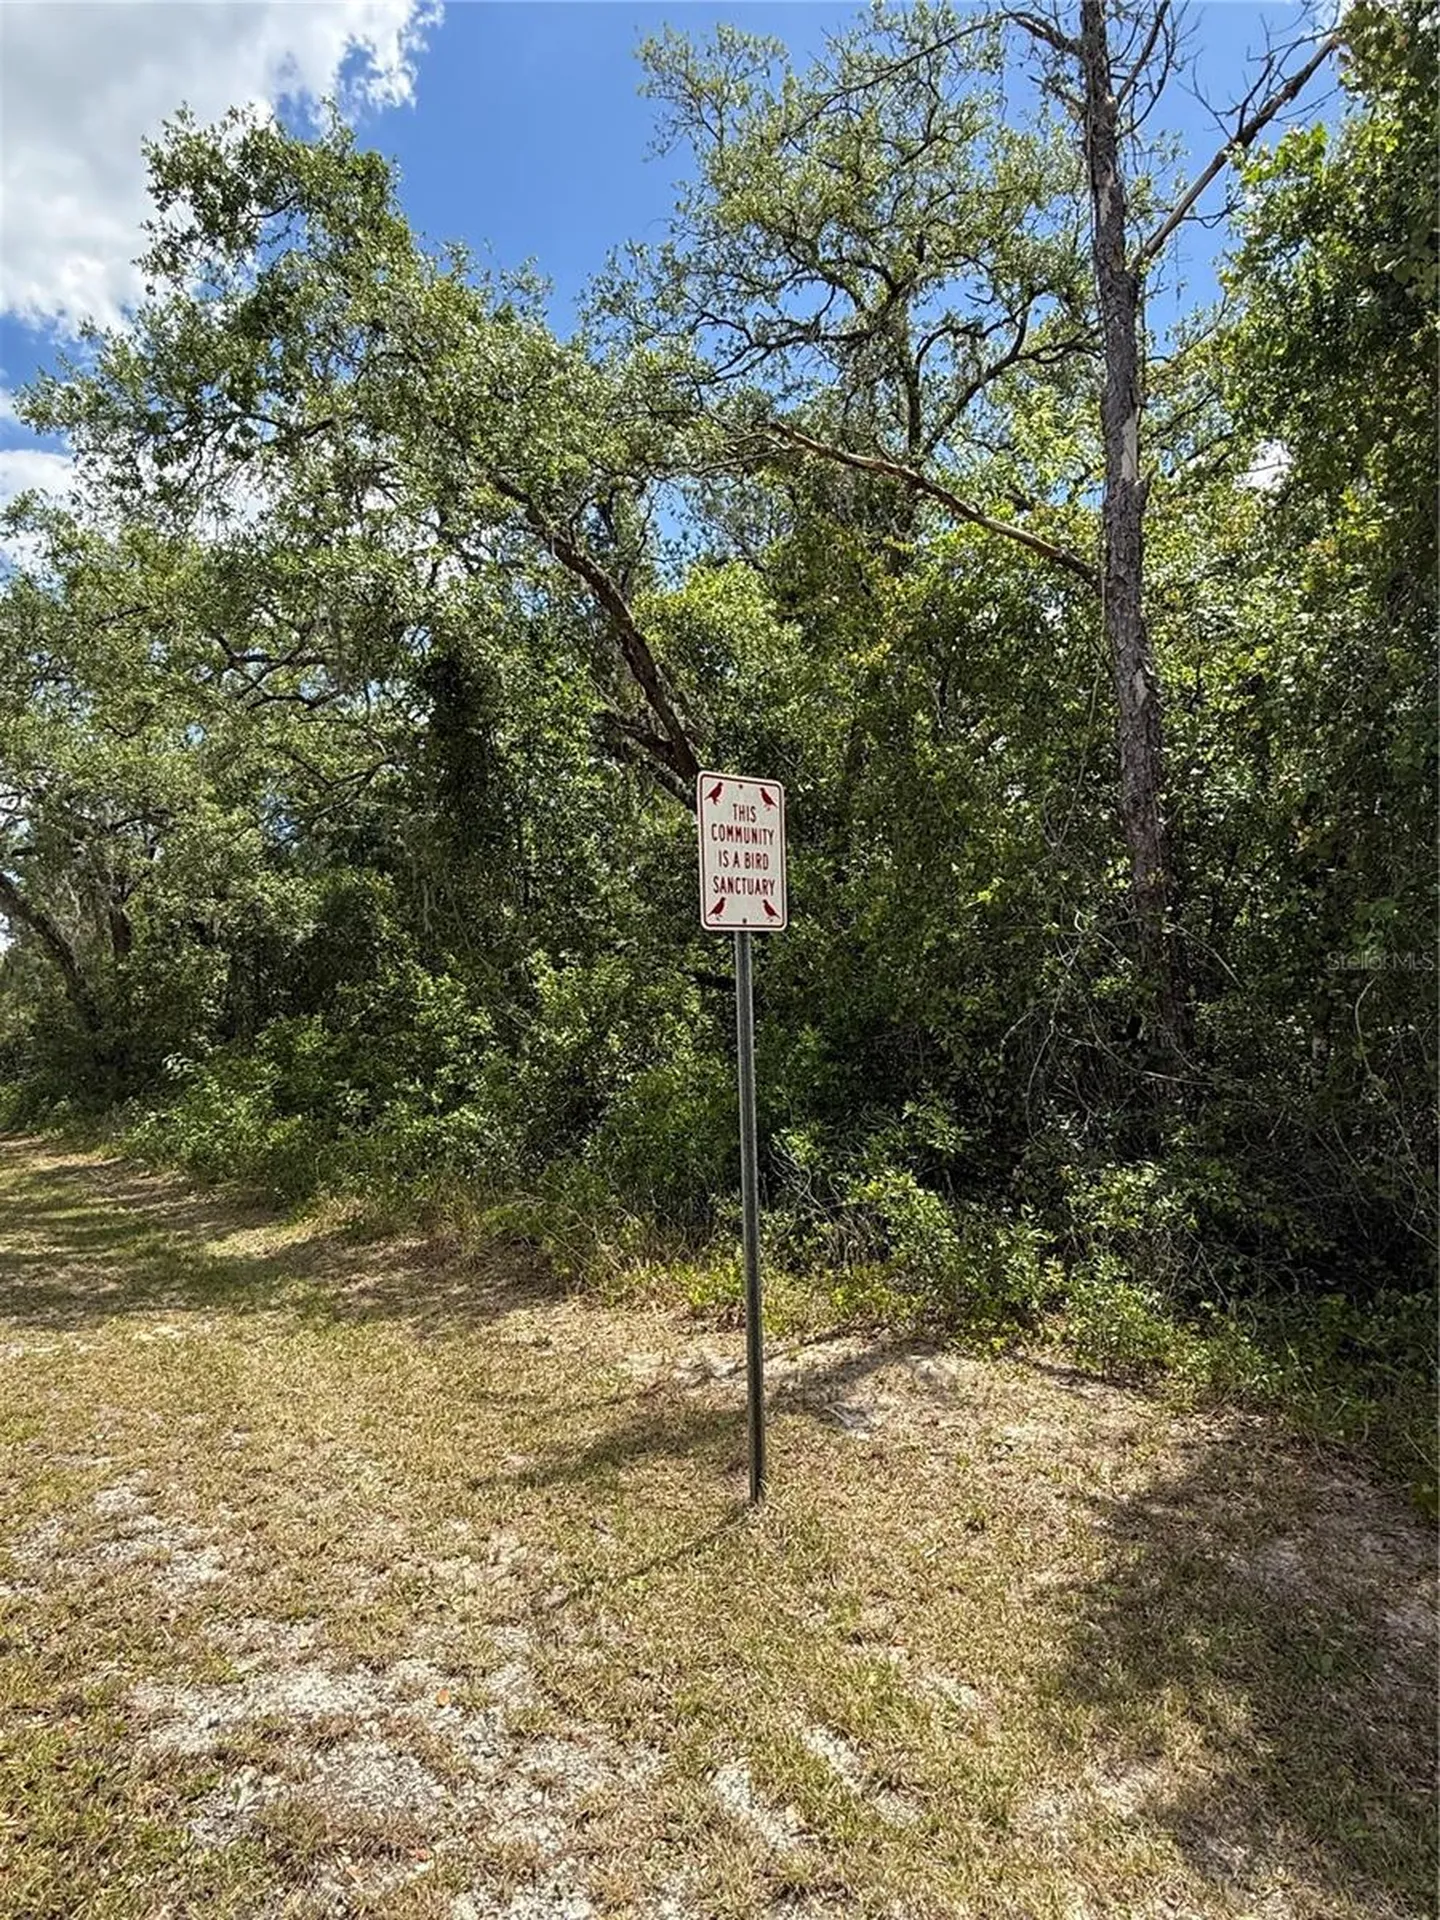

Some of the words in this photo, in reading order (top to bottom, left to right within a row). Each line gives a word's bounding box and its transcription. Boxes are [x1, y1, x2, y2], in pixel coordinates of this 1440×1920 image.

[732, 803, 757, 823] THIS
[711, 823, 775, 845] COMMUNITY
[718, 850, 729, 868] IS
[732, 851, 741, 869] A
[744, 852, 769, 870] BIRD
[713, 875, 775, 896] SANCTUARY
